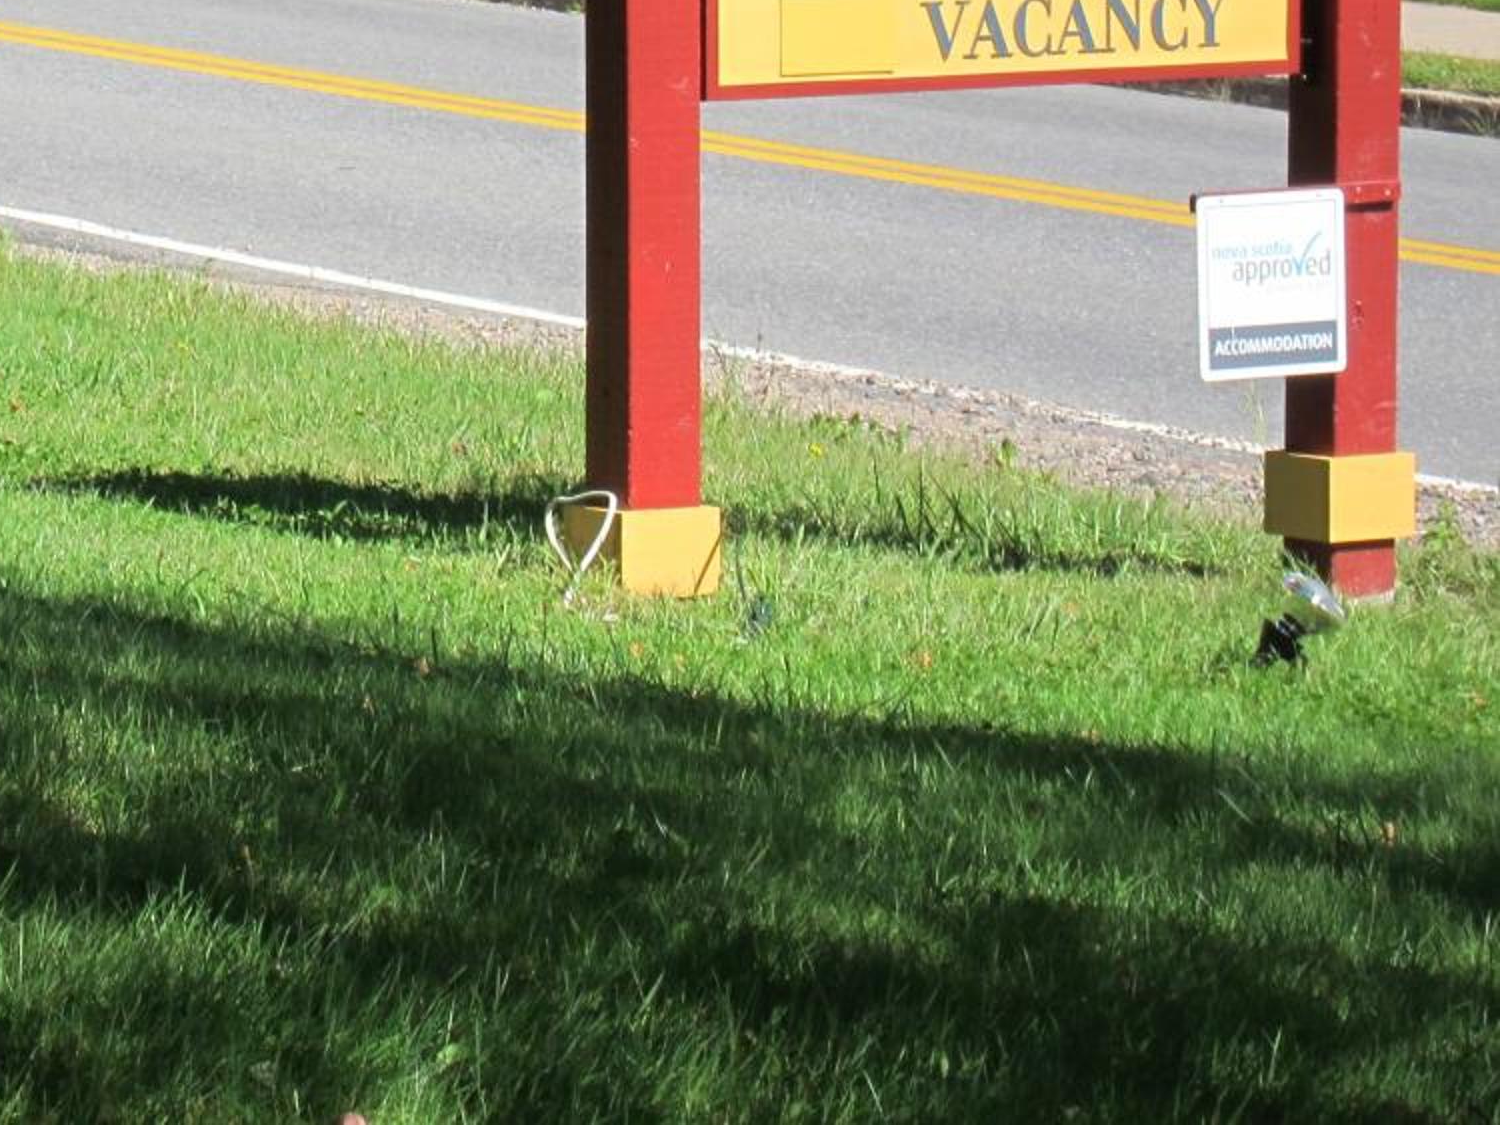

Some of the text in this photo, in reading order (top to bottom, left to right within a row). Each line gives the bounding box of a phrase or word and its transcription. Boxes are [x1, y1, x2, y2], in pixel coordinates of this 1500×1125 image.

[1232, 236, 1332, 286] approved
[1251, 240, 1293, 257] scotia
[1214, 332, 1333, 357] ACCOMMODATION
